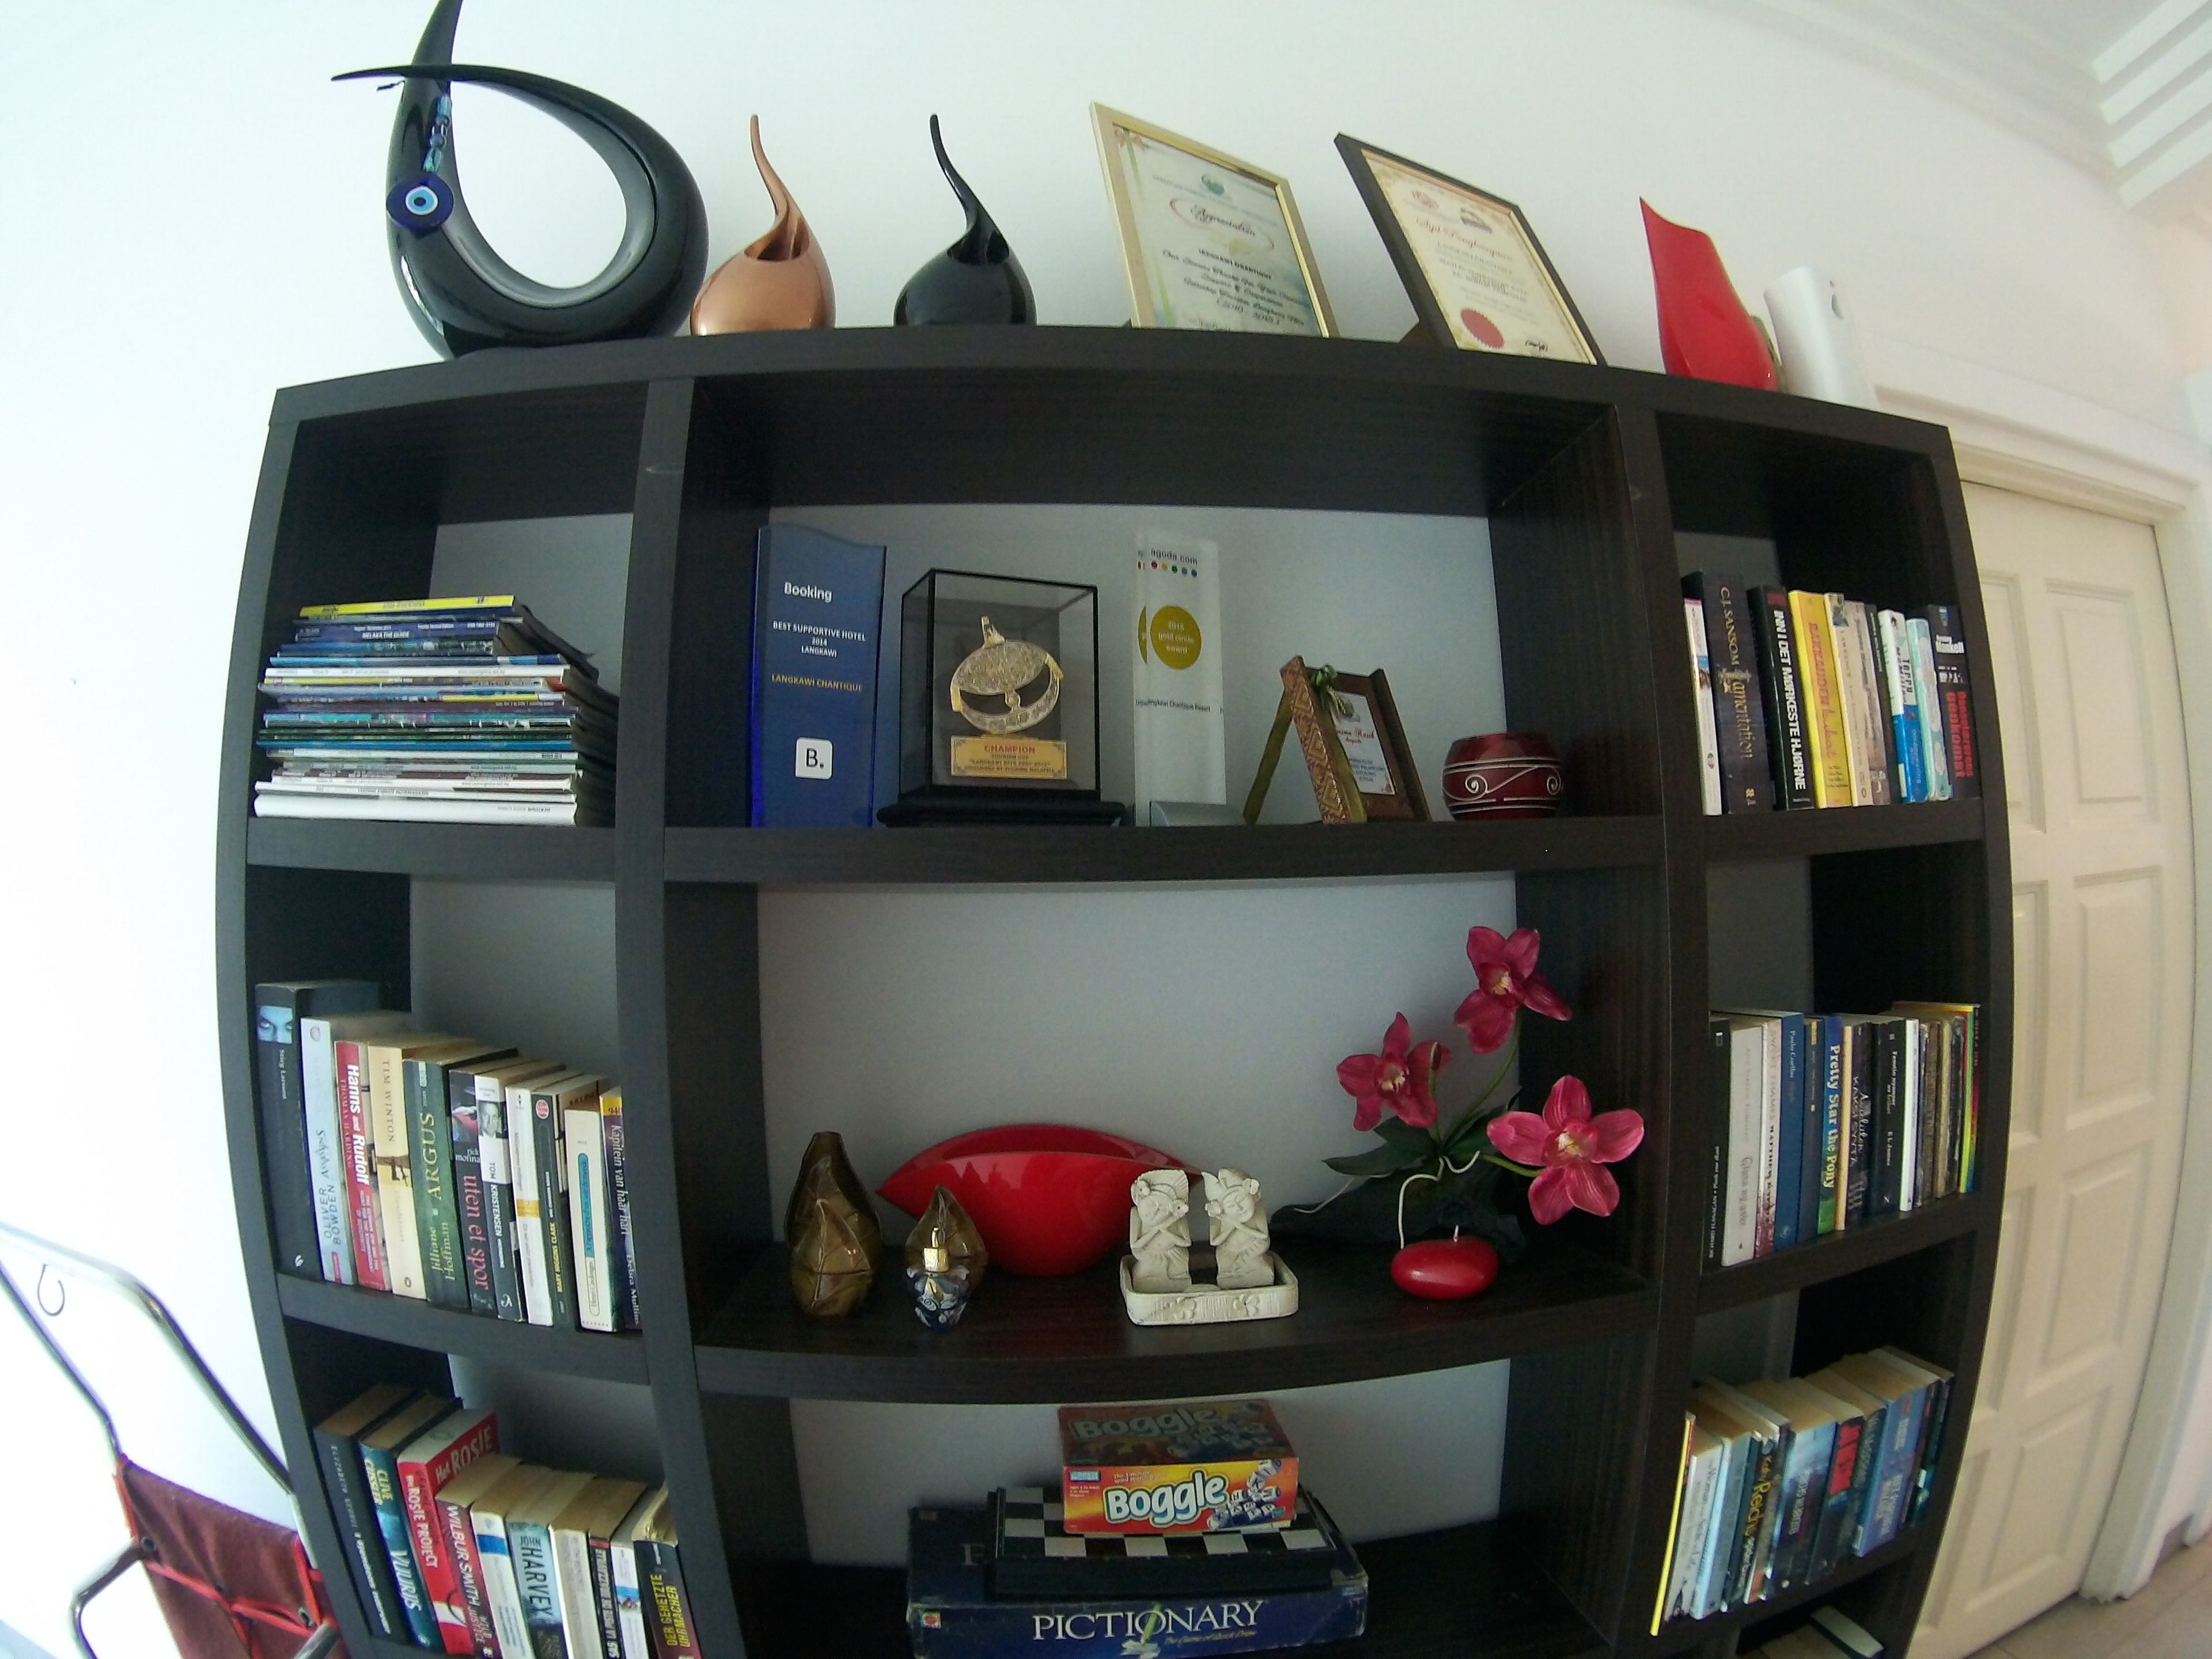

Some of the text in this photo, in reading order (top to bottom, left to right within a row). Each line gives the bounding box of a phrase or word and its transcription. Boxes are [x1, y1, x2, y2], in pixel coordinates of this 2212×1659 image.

[784, 581, 832, 603] Booking
[772, 620, 866, 642] BEST SUPPORTIVE HOTEL
[1721, 608, 1740, 666] SANSOM
[1772, 609, 1784, 632] INN
[801, 645, 837, 657] LANGKAWI
[1778, 640, 1791, 665] DET
[772, 673, 862, 692] LANGKAWI CHANTIQUE
[1783, 666, 1801, 737] MØRKESTE
[984, 745, 1035, 754] CHAMPION
[1788, 739, 1806, 791] HJØRNE
[346, 1064, 370, 1187] Hanns and Rudolf
[382, 1059, 395, 1143] TIM WINTON
[1823, 1044, 1840, 1190] Pretty Star the Pony
[420, 1112, 443, 1200] ARGUS
[488, 1161, 497, 1180] TOM
[611, 1124, 631, 1236] Kapitein van haar hart
[319, 1188, 332, 1239] OLIVER
[327, 1184, 342, 1246] BOWDEN
[463, 1174, 489, 1291] uten et spor
[490, 1183, 503, 1238] KRISTENSEN
[440, 1221, 455, 1281] Hoffman
[1073, 1407, 1217, 1439] Boggle
[450, 1426, 493, 1476] ROSIE
[376, 1469, 393, 1502] CLIVE
[1105, 1470, 1228, 1525] Boggle
[406, 1486, 424, 1522] ROSIE
[416, 1521, 438, 1569] PROJECT
[520, 1535, 541, 1548] JOHN
[447, 1504, 481, 1607] WILBUR SMITH
[521, 1547, 554, 1618] HARVEY
[469, 1606, 485, 1645] JUSTICE
[478, 1615, 493, 1640] WILD
[665, 1585, 691, 1648] UHRMACHER
[666, 1627, 679, 1646] DER
[1032, 1600, 1264, 1641] PICTIONARY
